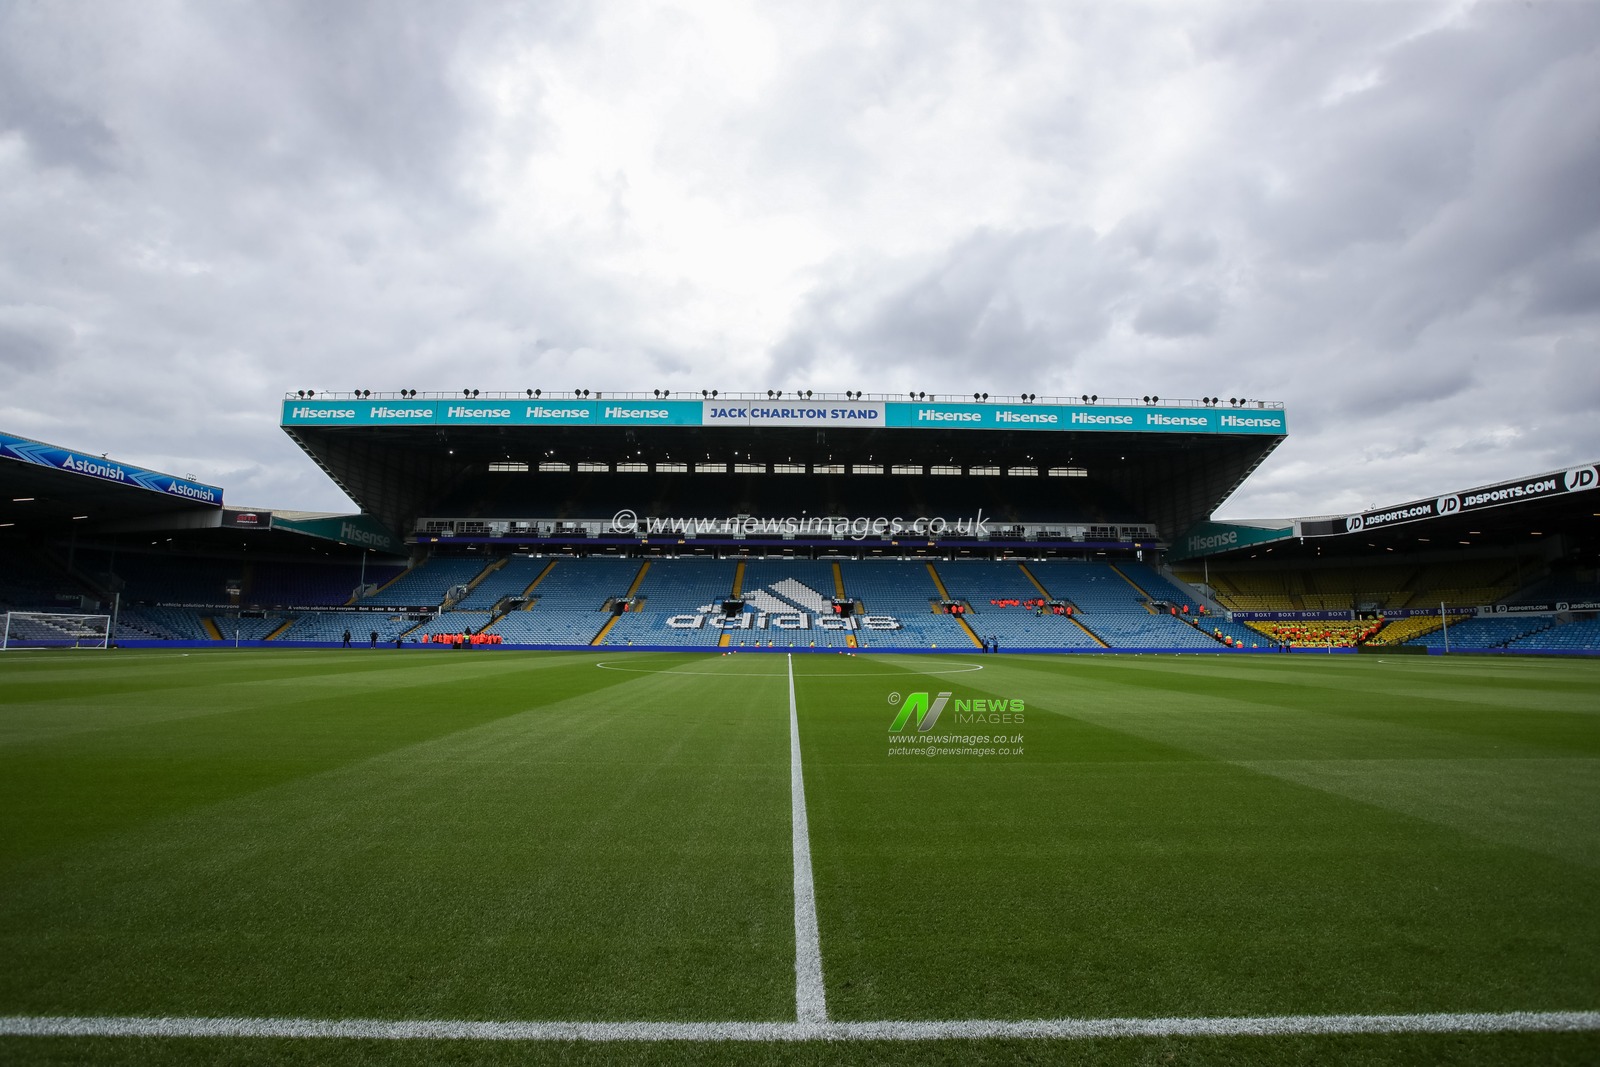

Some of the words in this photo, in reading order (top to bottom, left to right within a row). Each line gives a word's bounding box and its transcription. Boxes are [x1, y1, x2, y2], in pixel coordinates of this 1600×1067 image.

[292, 407, 356, 419] Hisense
[369, 407, 433, 418] Hisense
[447, 406, 511, 418] Hisense
[526, 406, 590, 418] Hisense
[604, 407, 669, 419] Hisense
[710, 408, 748, 418] JACK
[750, 408, 827, 419] CHARLTON
[830, 409, 879, 419] STAND
[918, 409, 982, 422] Hisense
[995, 411, 1058, 423] Hisense
[1071, 412, 1133, 424] Hisense
[1146, 413, 1208, 426] Hisense
[1220, 415, 1281, 427] Hisense
[62, 454, 125, 481] Astonish
[168, 480, 215, 502] Astonish
[1347, 515, 1363, 532] JD
[1364, 504, 1431, 526] JDSPORTS.COM
[1439, 496, 1459, 514] JD
[1462, 479, 1556, 508] JDSPORTS.COM
[1568, 468, 1595, 490] JD
[340, 521, 391, 548] Hisense
[1188, 530, 1238, 552] Hisense
